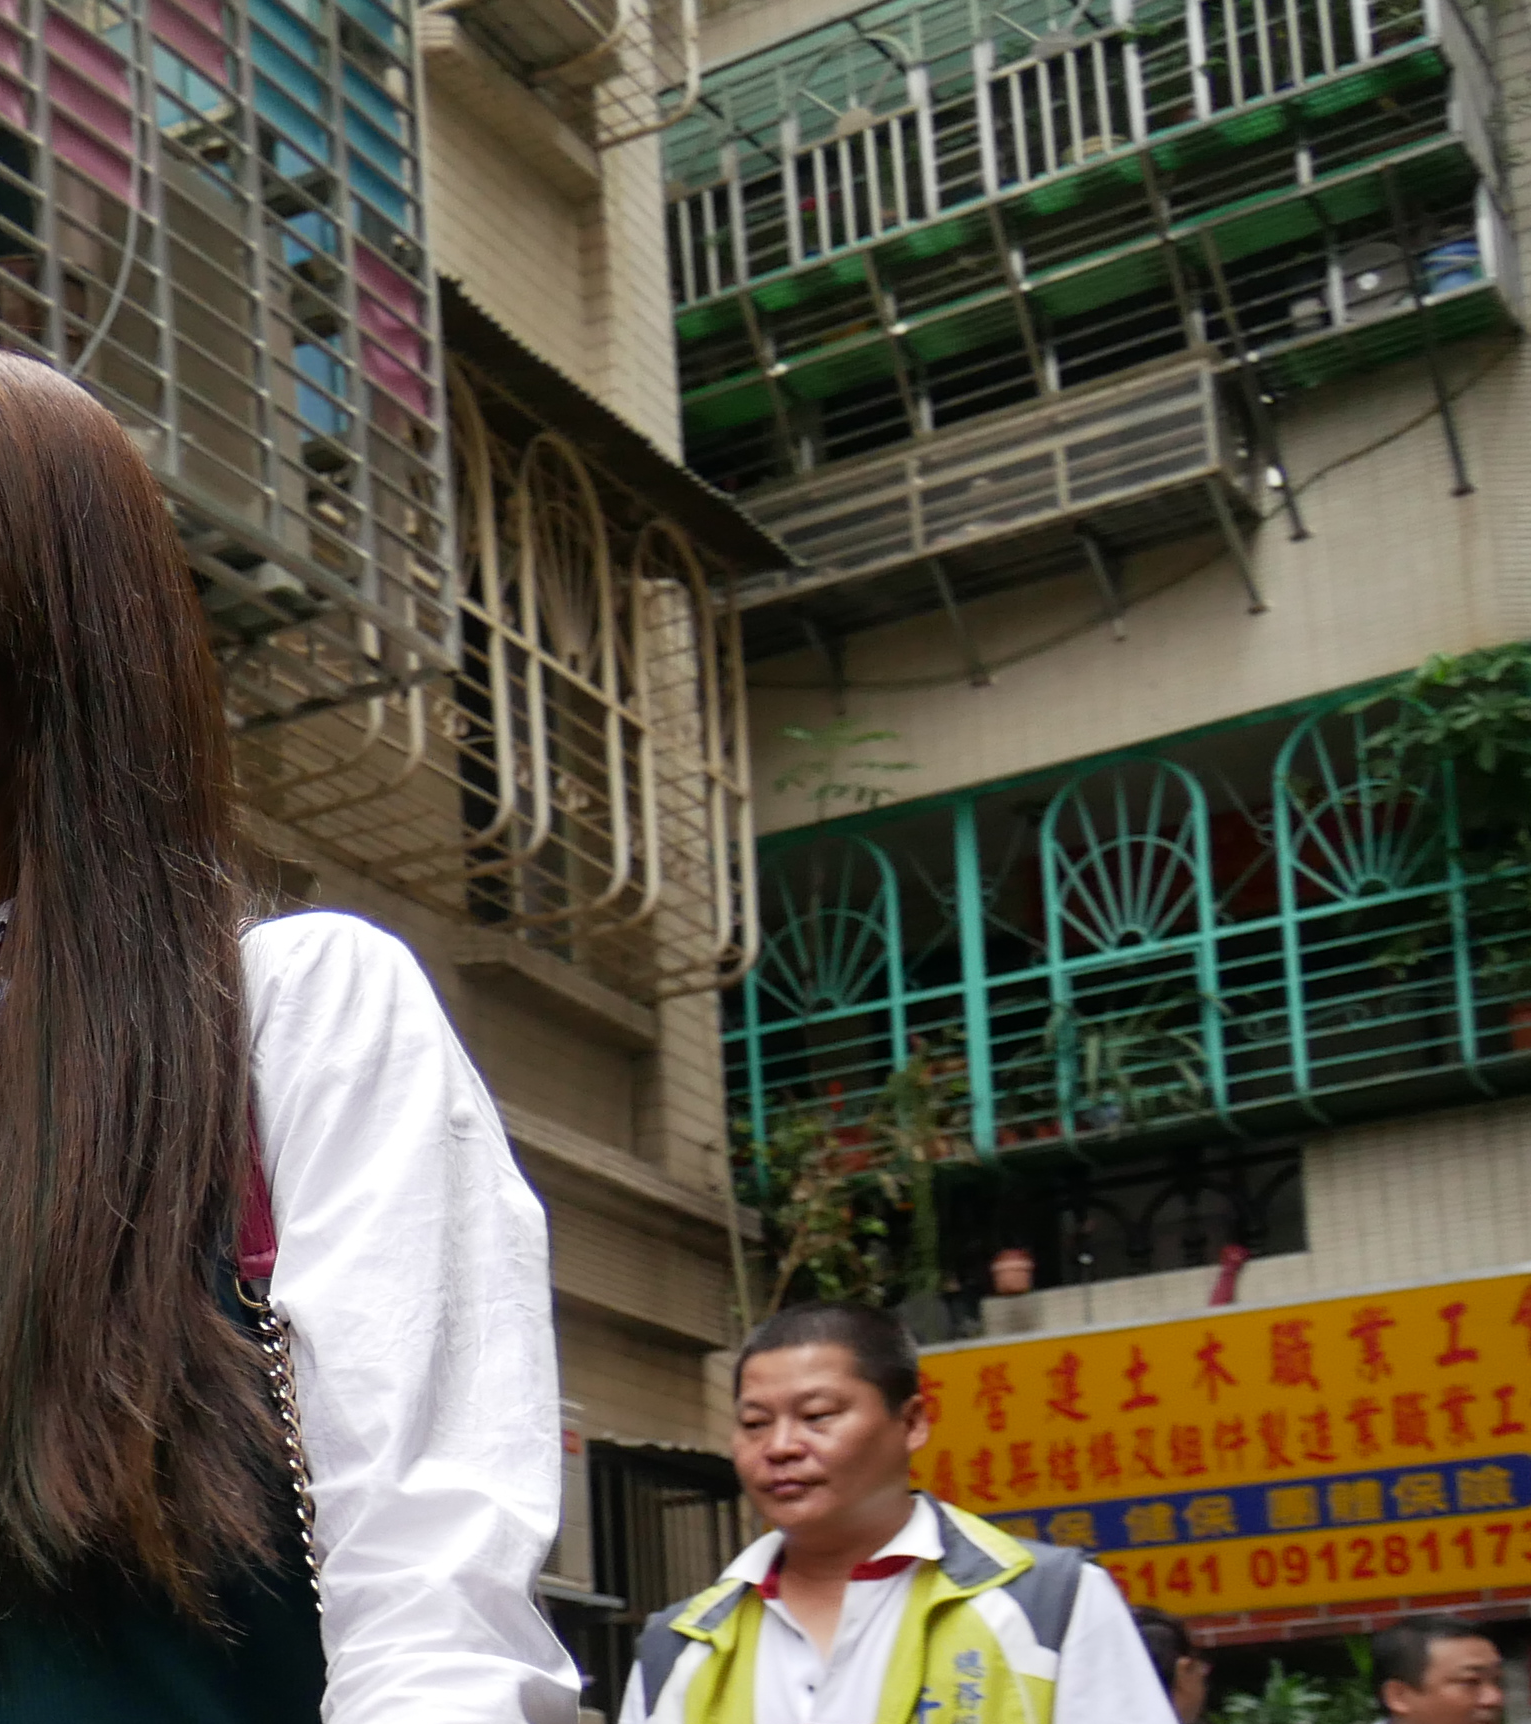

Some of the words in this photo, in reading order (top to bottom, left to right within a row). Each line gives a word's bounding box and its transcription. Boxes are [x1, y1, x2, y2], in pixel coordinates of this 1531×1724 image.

[917, 1284, 1531, 1432] 營建土木職業工
